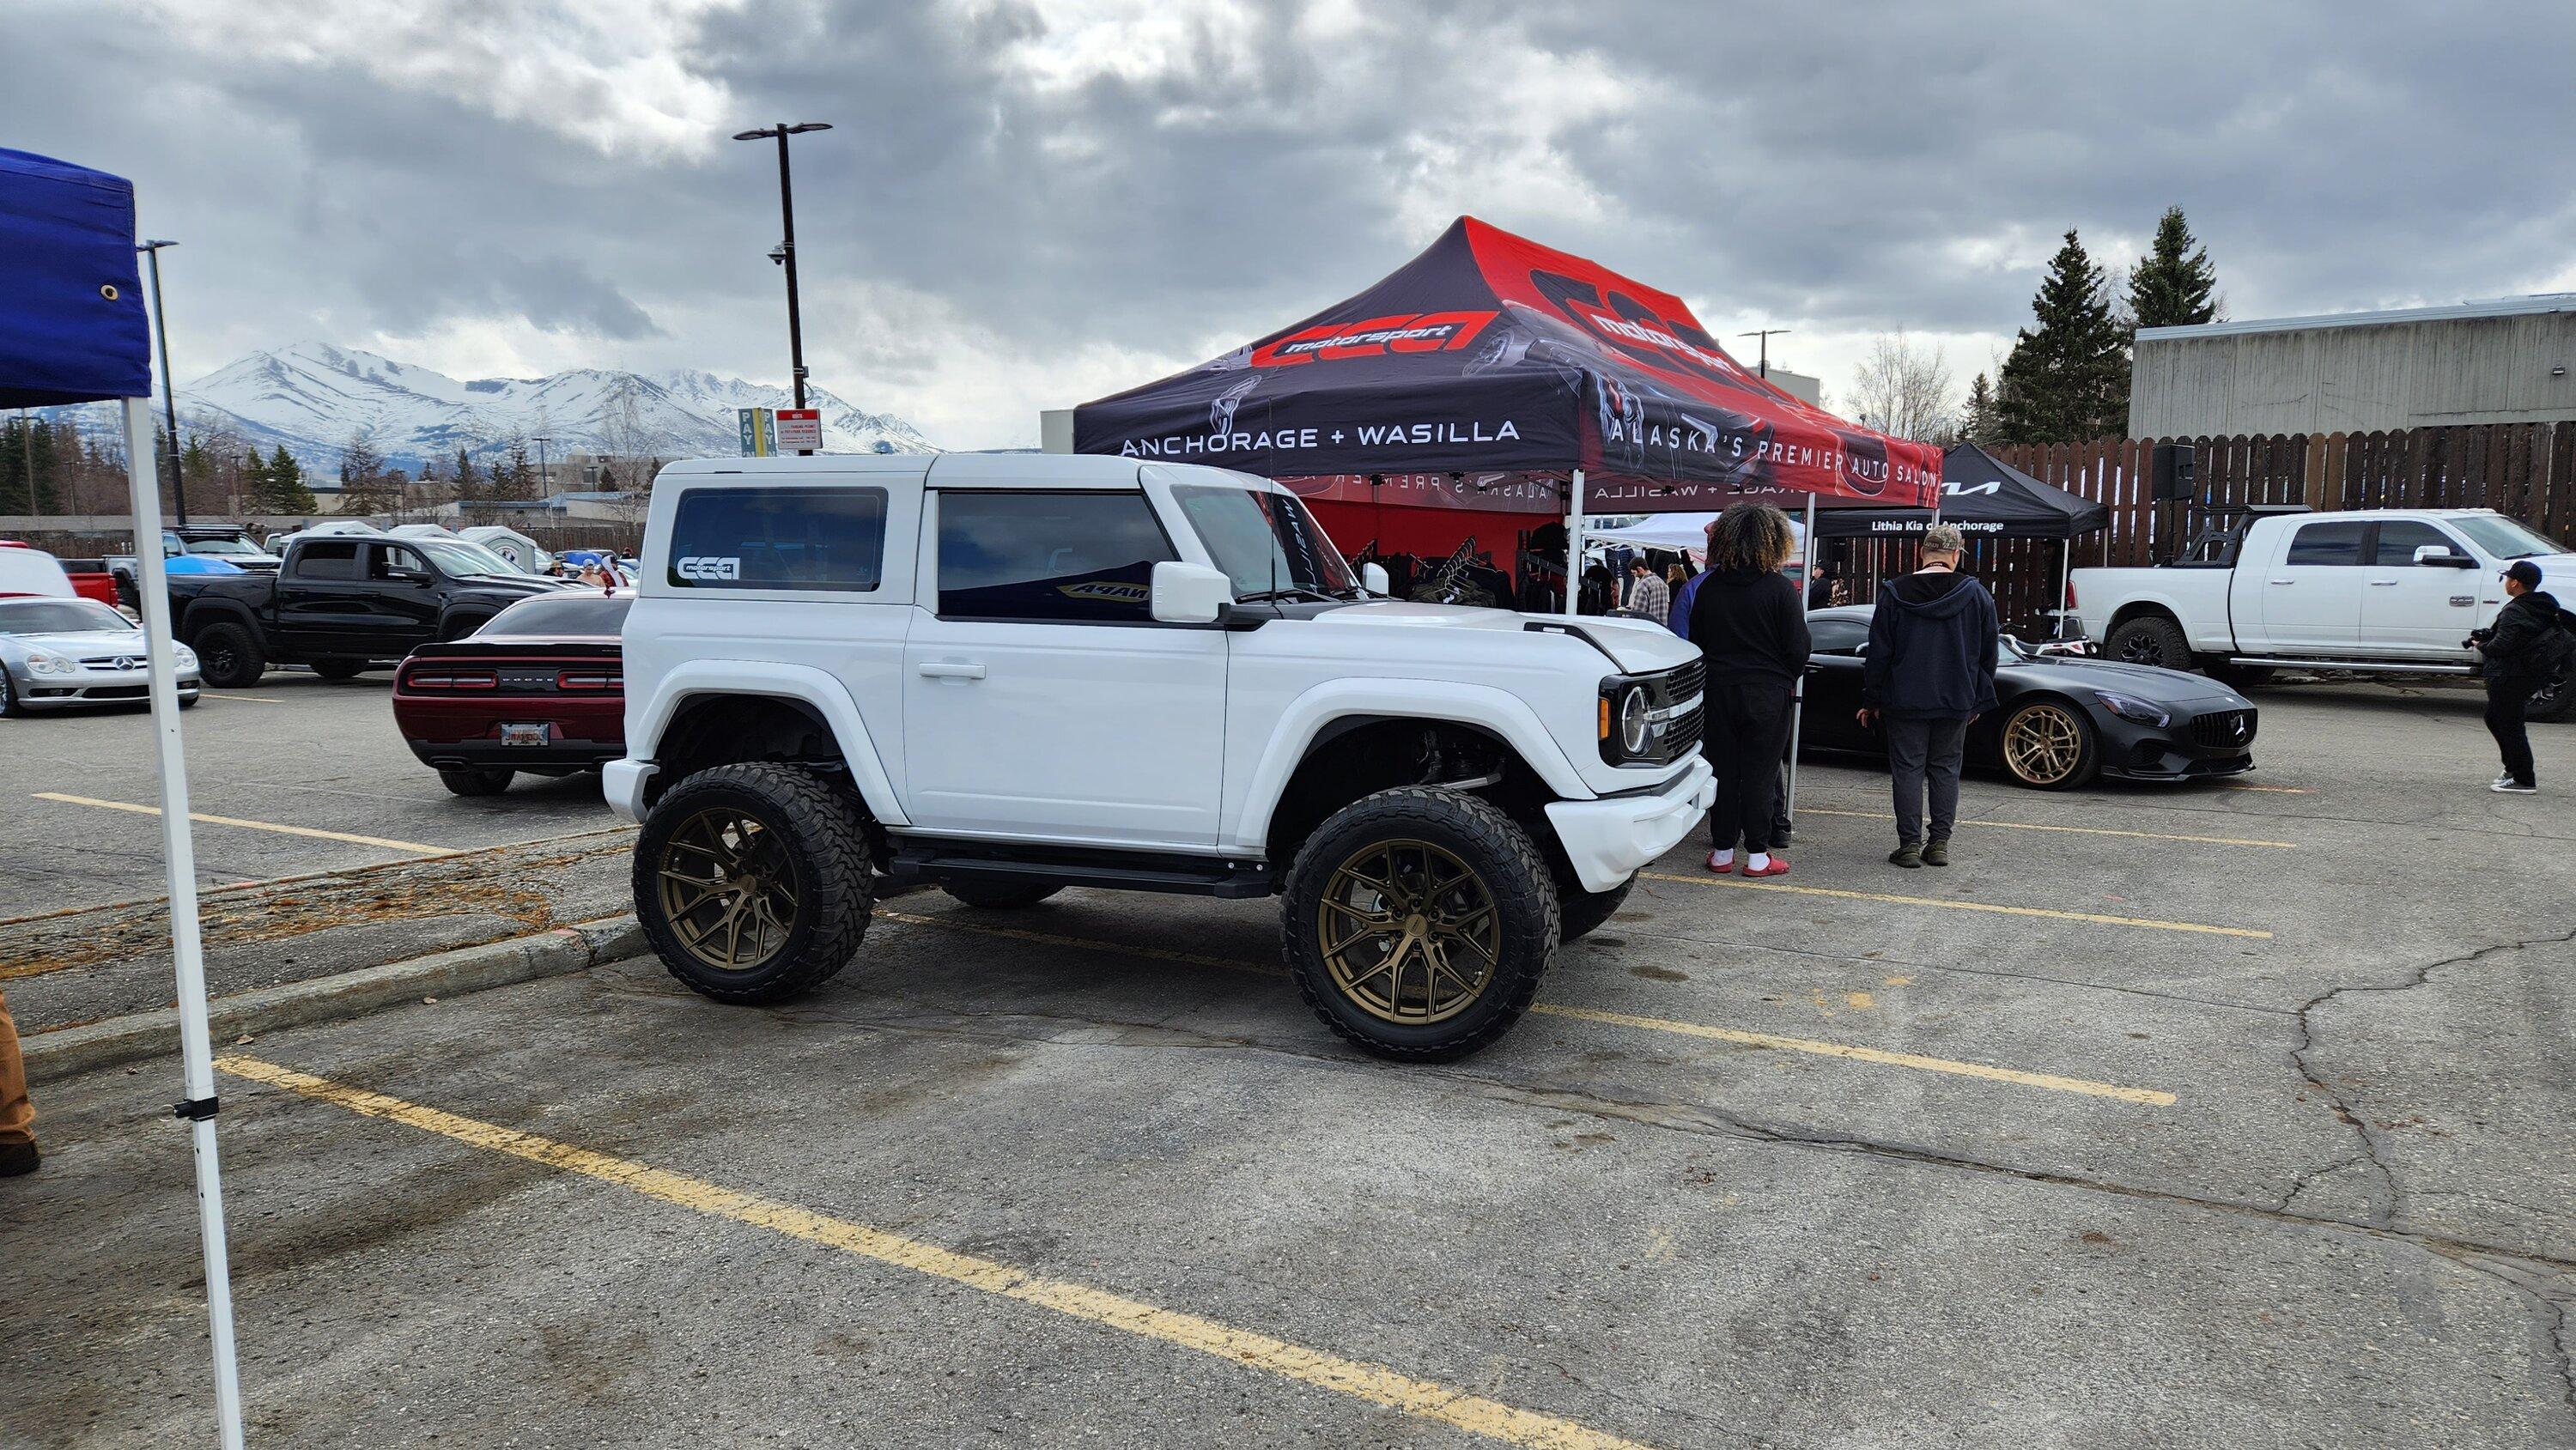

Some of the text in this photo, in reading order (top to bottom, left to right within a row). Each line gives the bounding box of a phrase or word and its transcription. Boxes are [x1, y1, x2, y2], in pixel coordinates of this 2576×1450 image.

[1285, 325, 1452, 354] motorsport
[1590, 313, 1742, 376] motorsport
[742, 412, 752, 445] PAY
[764, 412, 773, 445] PAY
[1121, 428, 1318, 457] ANCHORAGE
[1358, 421, 1521, 446] WASILLA
[1608, 417, 1937, 488] ALASKA'S PREMIER AUTO SALON
[1872, 521, 1903, 531] Lithia
[1905, 520, 1923, 531] Kia
[1942, 520, 2004, 533] Anchorage
